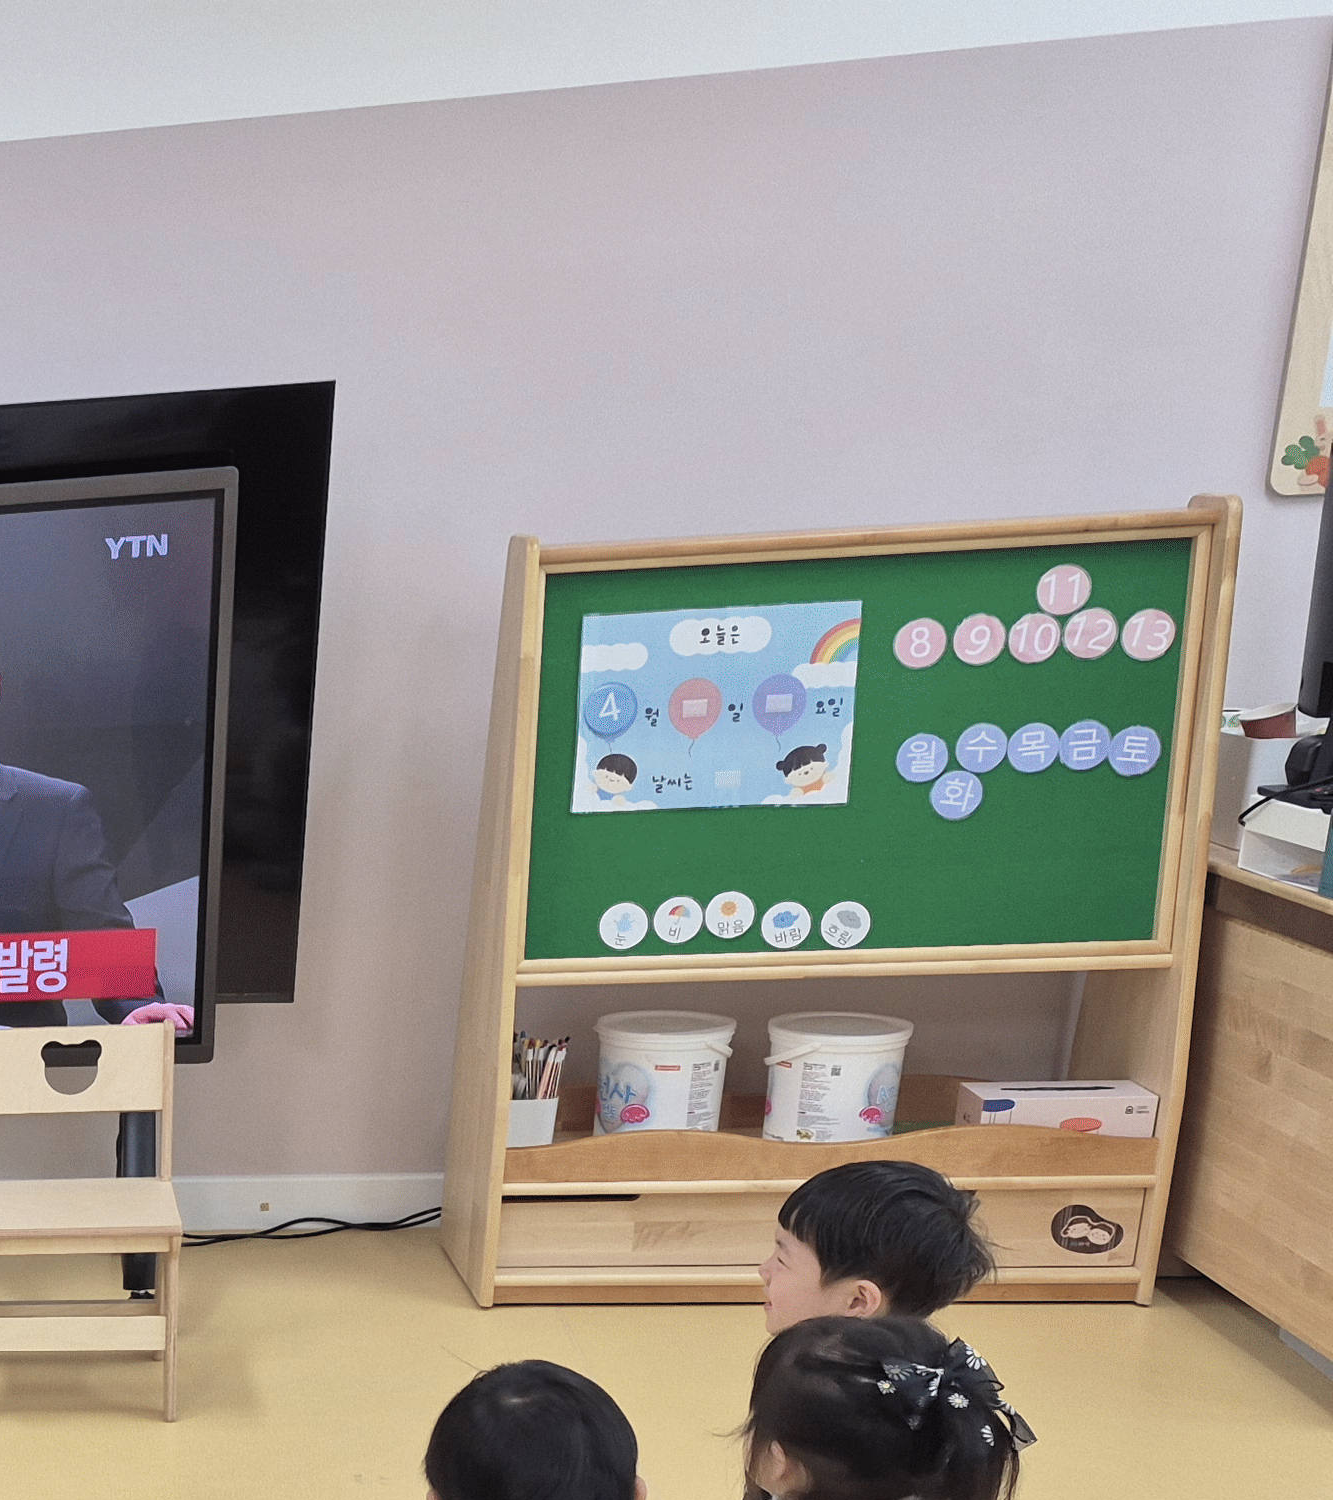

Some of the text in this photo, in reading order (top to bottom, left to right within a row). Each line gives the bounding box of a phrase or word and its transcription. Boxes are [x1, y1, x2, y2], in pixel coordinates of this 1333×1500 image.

[105, 534, 168, 559] YTN
[1044, 573, 1081, 605] 11
[699, 624, 740, 645] 오늘은
[910, 616, 1171, 657] 8 9 10 12 13
[599, 692, 843, 727] 4 월 일 요일
[907, 729, 1149, 773] 월 수 목 금 토
[652, 773, 693, 793] 날씨는
[939, 778, 974, 812] 화
[668, 927, 681, 940] 비
[717, 919, 744, 936] 맑음
[775, 928, 801, 944] 바람
